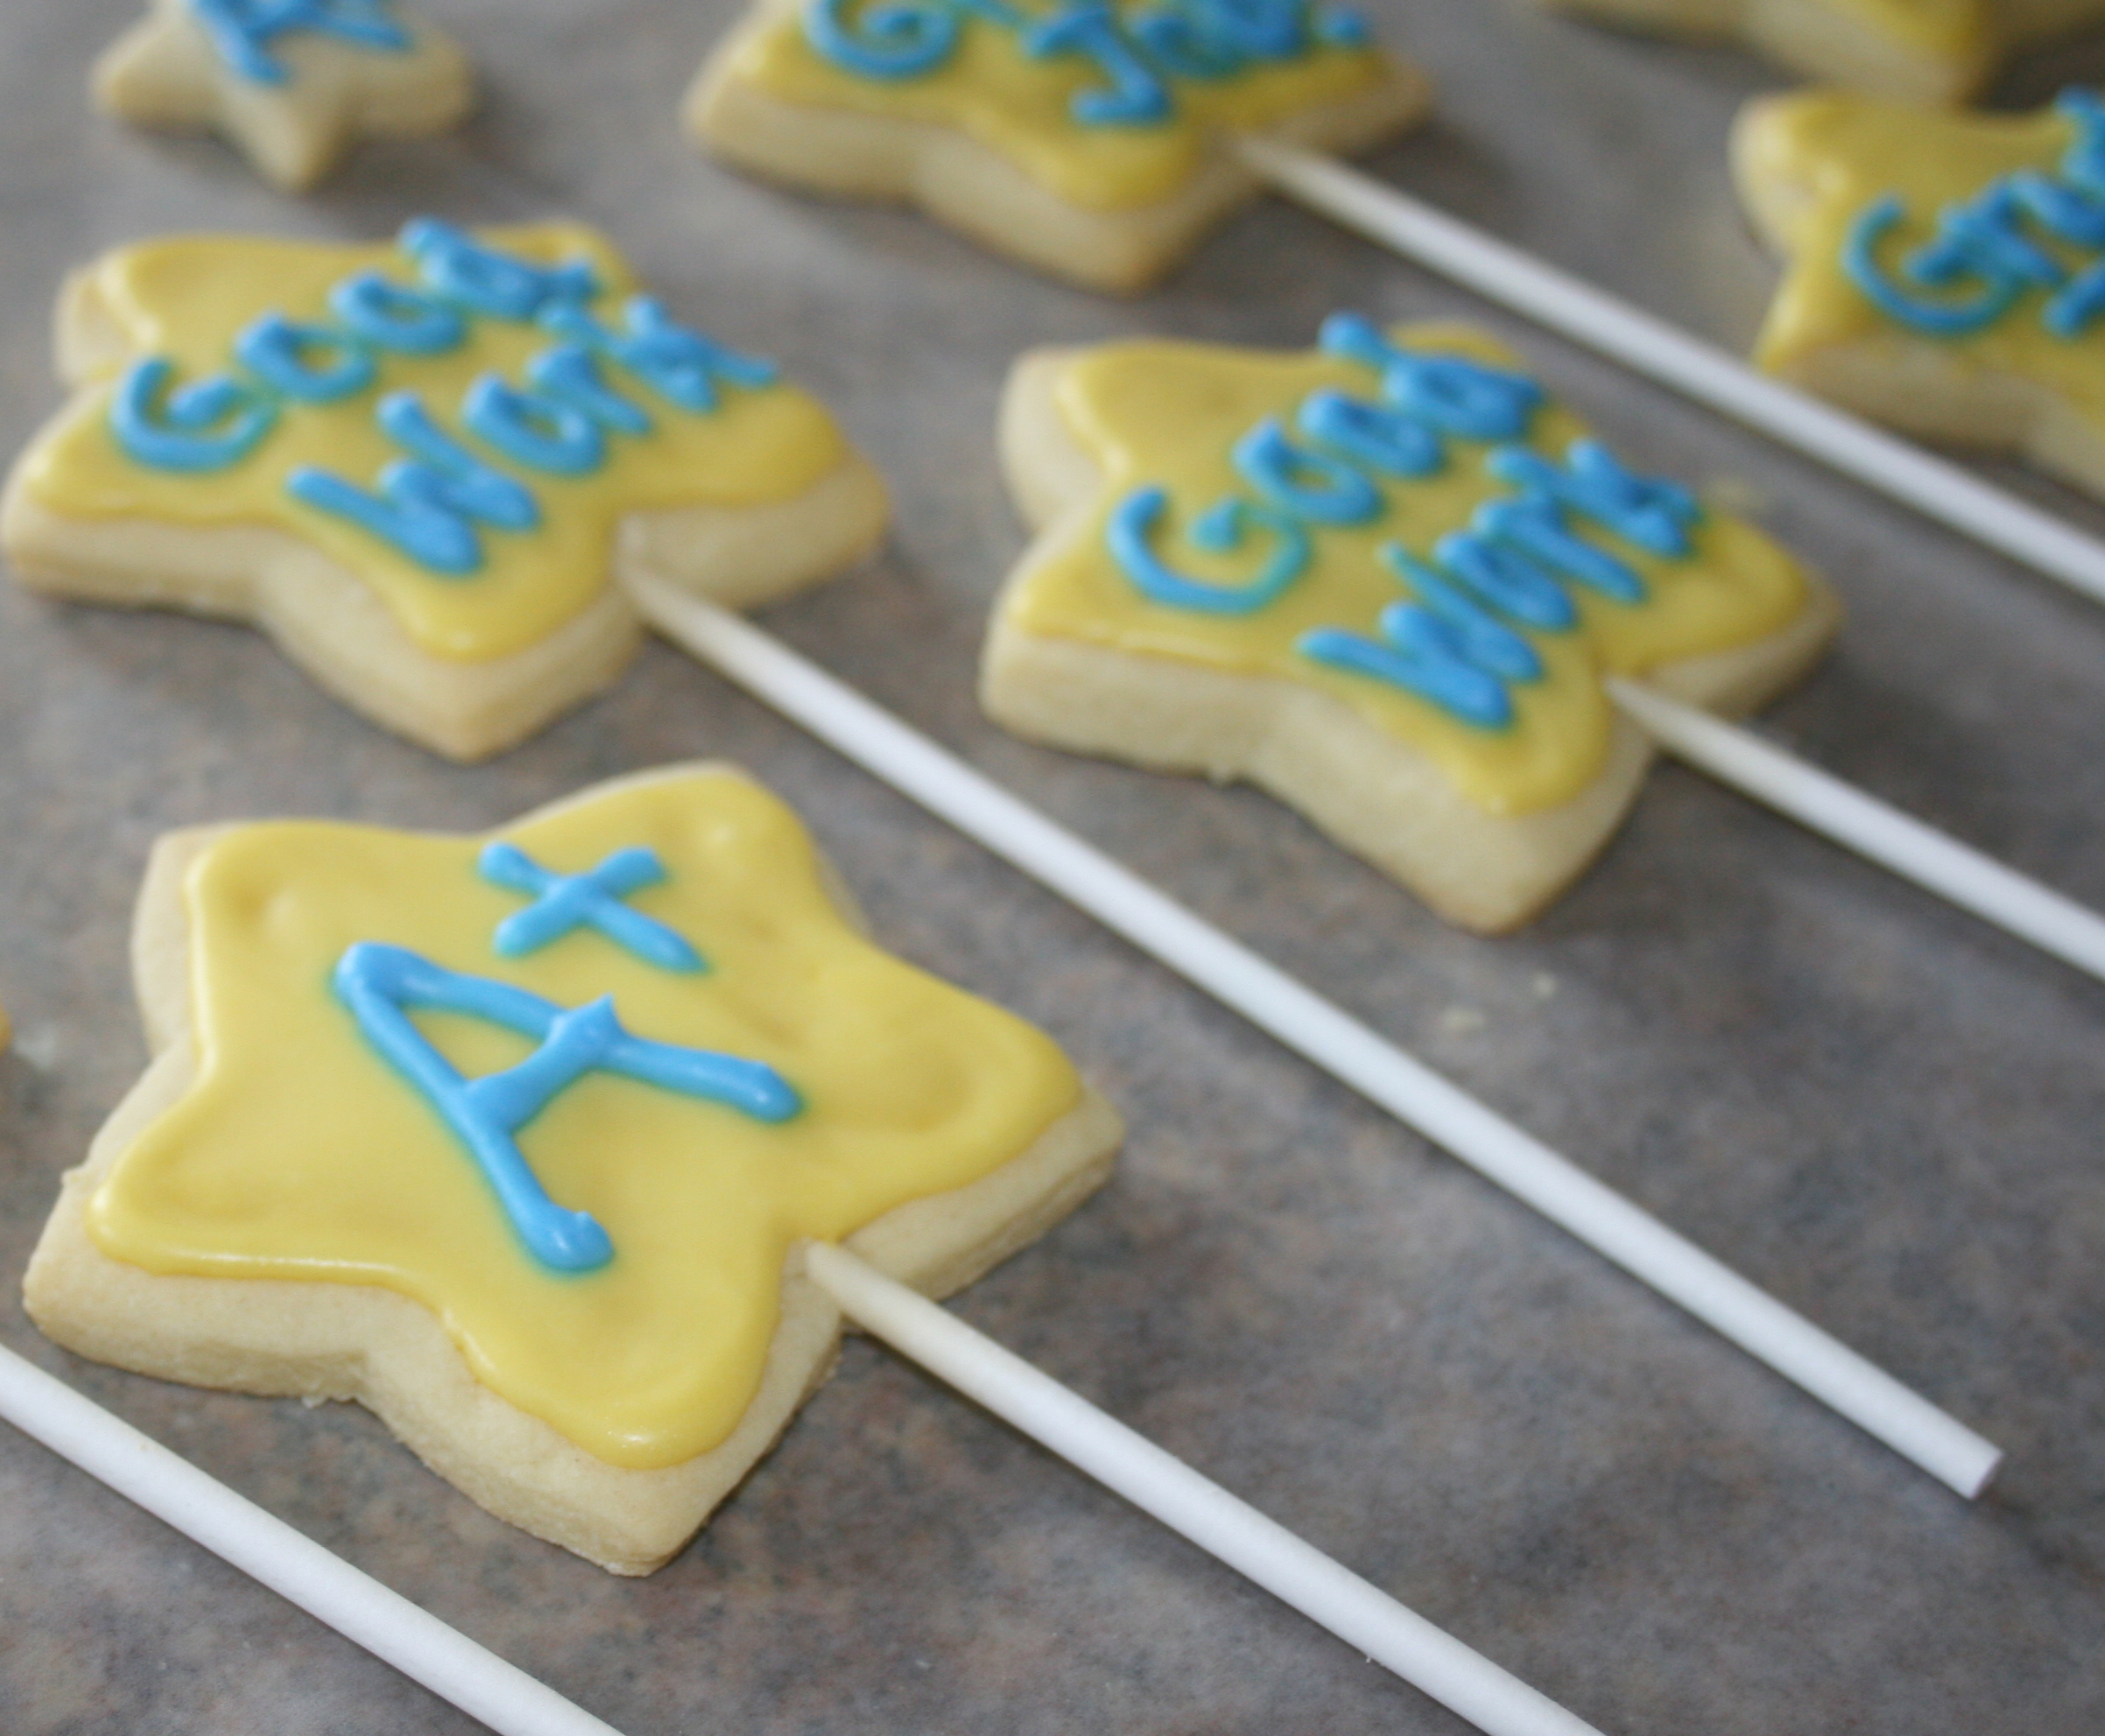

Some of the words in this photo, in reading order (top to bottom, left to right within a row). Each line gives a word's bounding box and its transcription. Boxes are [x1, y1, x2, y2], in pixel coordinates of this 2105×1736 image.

[110, 215, 602, 473] Good
[285, 294, 779, 578] Work
[1105, 310, 1545, 616] Good
[1294, 436, 1701, 732] Work
[330, 840, 802, 1276] A+
